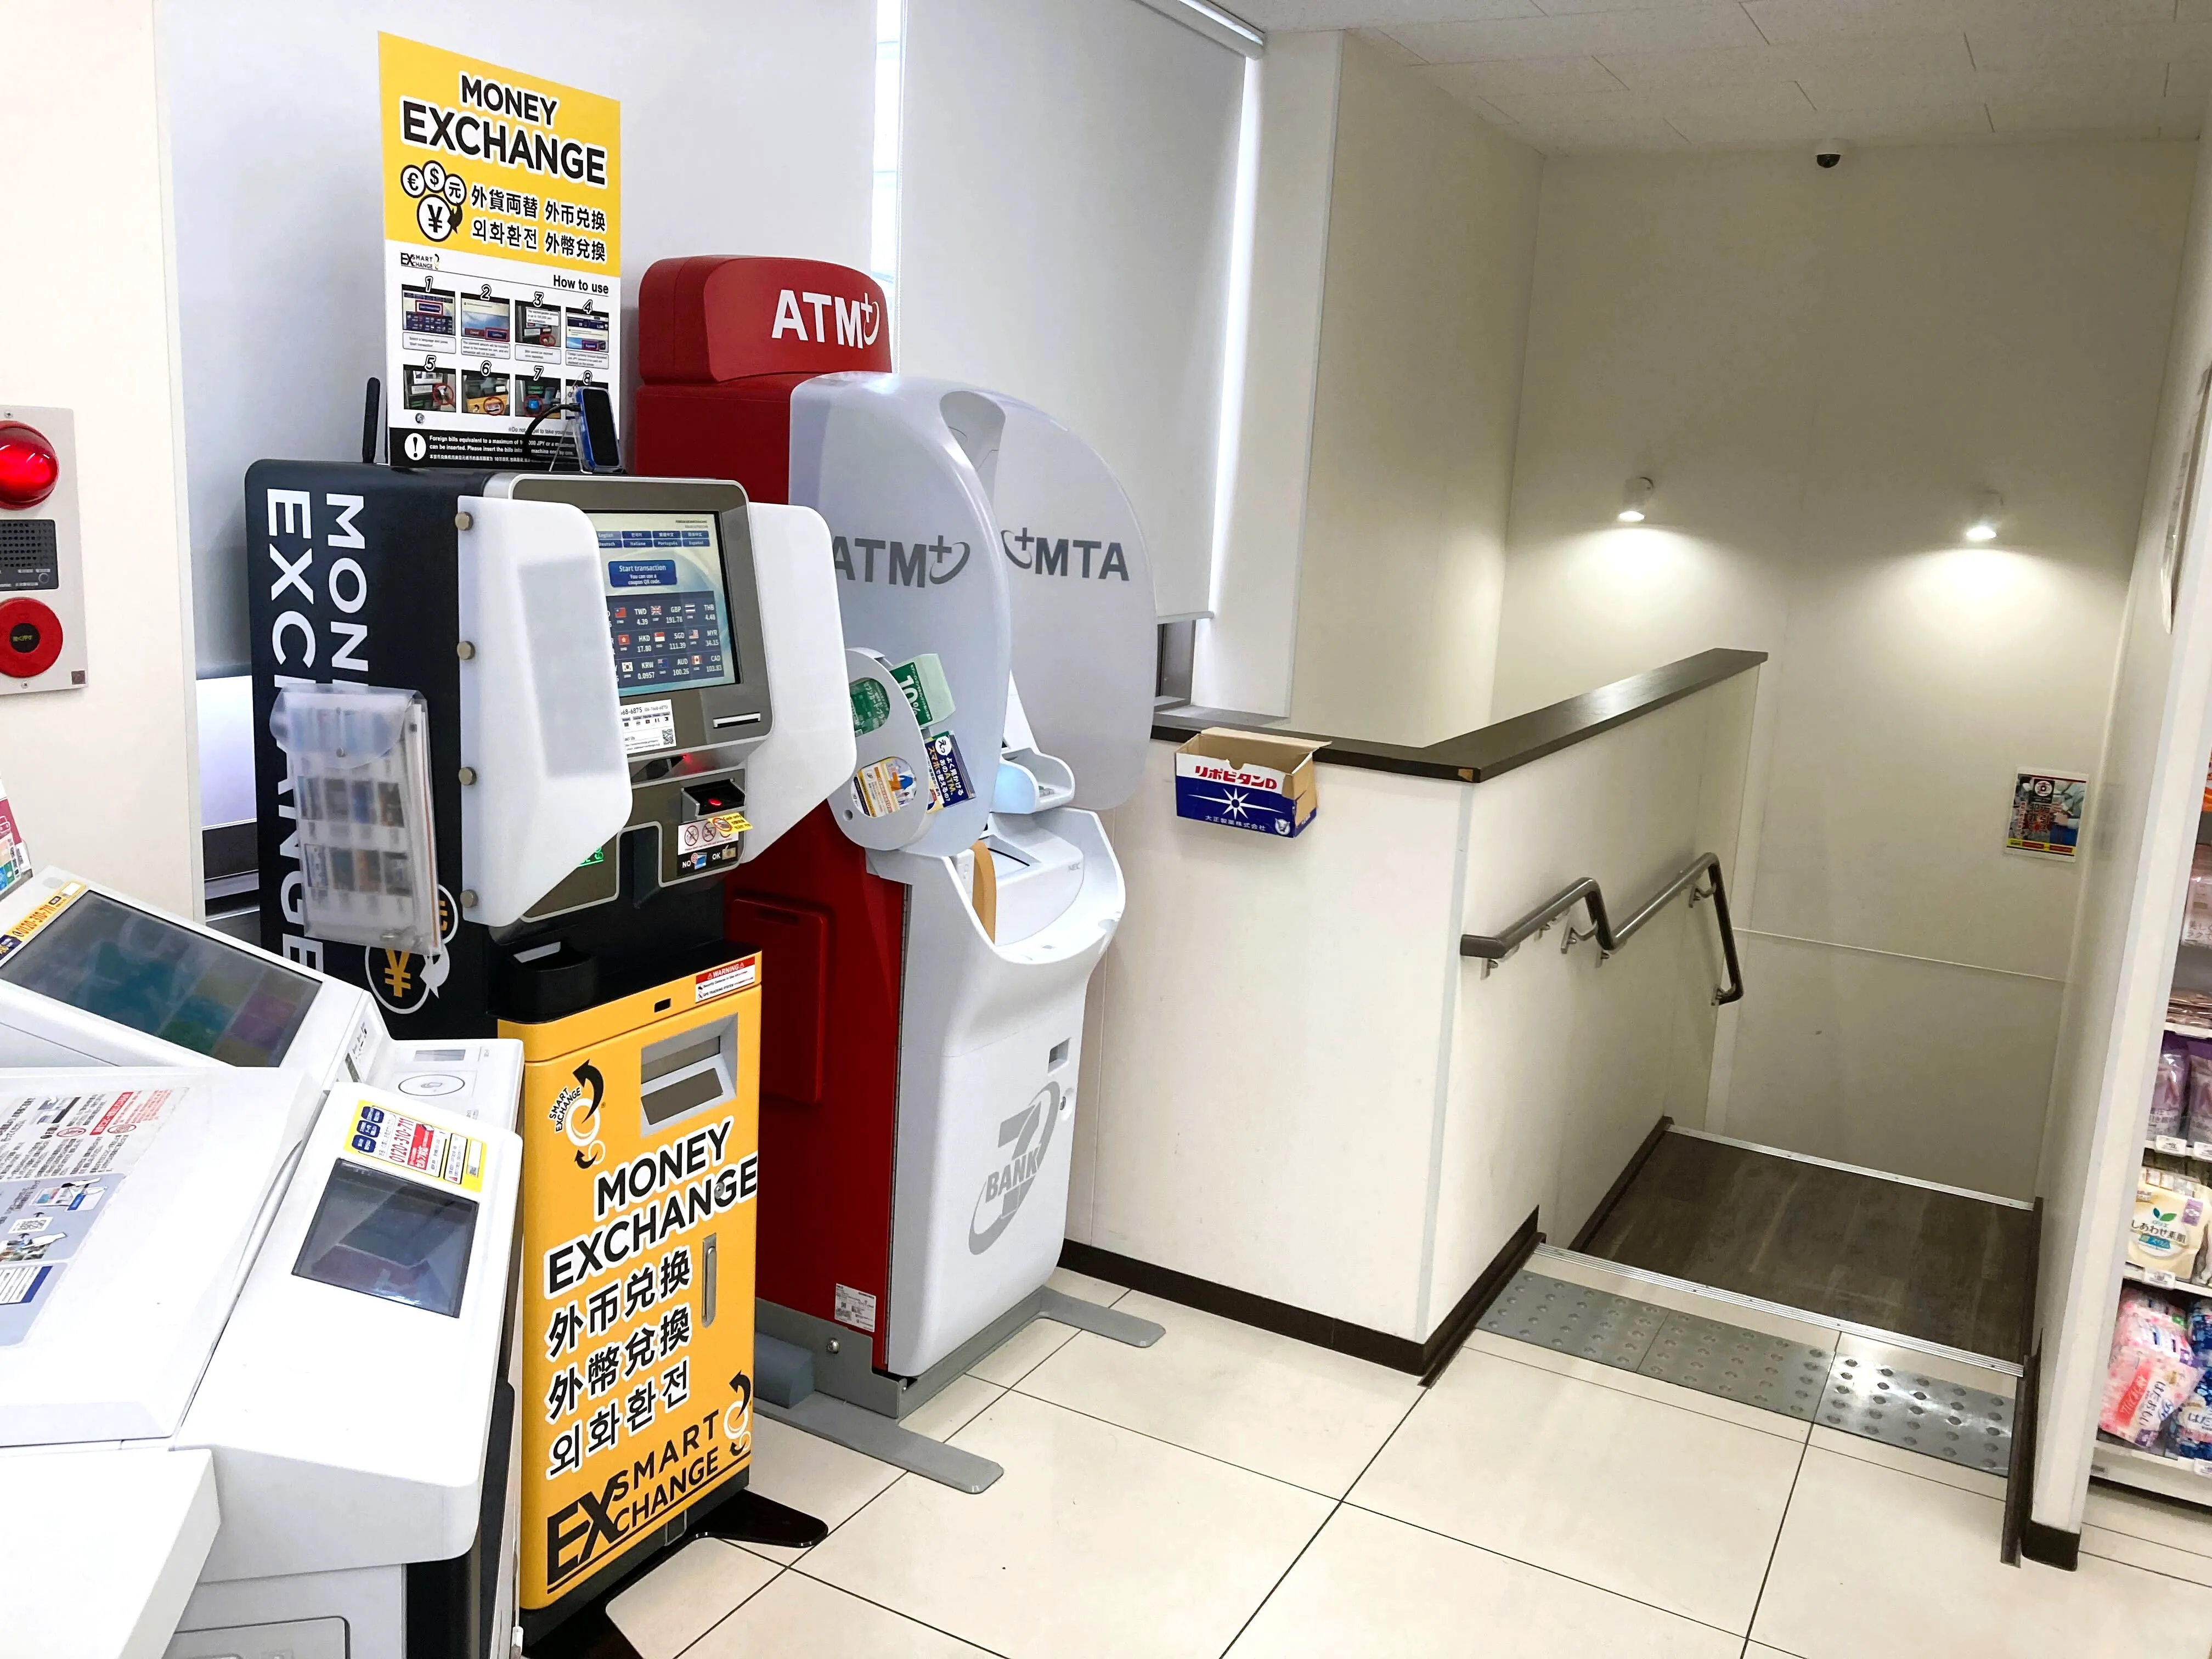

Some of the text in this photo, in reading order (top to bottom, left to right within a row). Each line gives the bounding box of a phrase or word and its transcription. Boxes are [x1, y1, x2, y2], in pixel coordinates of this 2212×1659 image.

[462, 75, 557, 125] MONEY
[403, 100, 606, 185] EXCHANGE
[471, 185, 606, 232] 外貨両替 外币兑换
[472, 219, 537, 250] 외화환전
[545, 233, 606, 262] 外幣兌換
[426, 276, 433, 292] 1
[481, 284, 492, 300] 2
[533, 292, 544, 307] 3
[553, 274, 609, 294] How to use
[583, 300, 593, 314] 4
[425, 356, 436, 372] 5
[481, 360, 492, 376] 6
[533, 365, 544, 381] 7
[583, 370, 593, 385] 8
[326, 493, 370, 689] MON
[938, 739, 947, 753] えっ
[946, 757, 964, 796] よく見かける
[1195, 765, 1278, 790] リポビタンD
[682, 860, 691, 868] NO
[712, 852, 721, 860] OK
[713, 963, 739, 978] WARNING
[549, 1087, 568, 1119] SMART
[556, 1087, 581, 1132] EXCHANGE
[388, 1117, 414, 1163] 0120-310-711
[598, 1121, 730, 1216] MONEY
[985, 1144, 1042, 1203] BANK
[550, 1155, 758, 1294] EXCHANGE
[549, 1249, 690, 1357] 外币兑换
[548, 1306, 690, 1420] 外幣兌換
[550, 1360, 687, 1476] 외화환전
[547, 1408, 719, 1587] EX SMART
[614, 1446, 719, 1534] CHANGE
